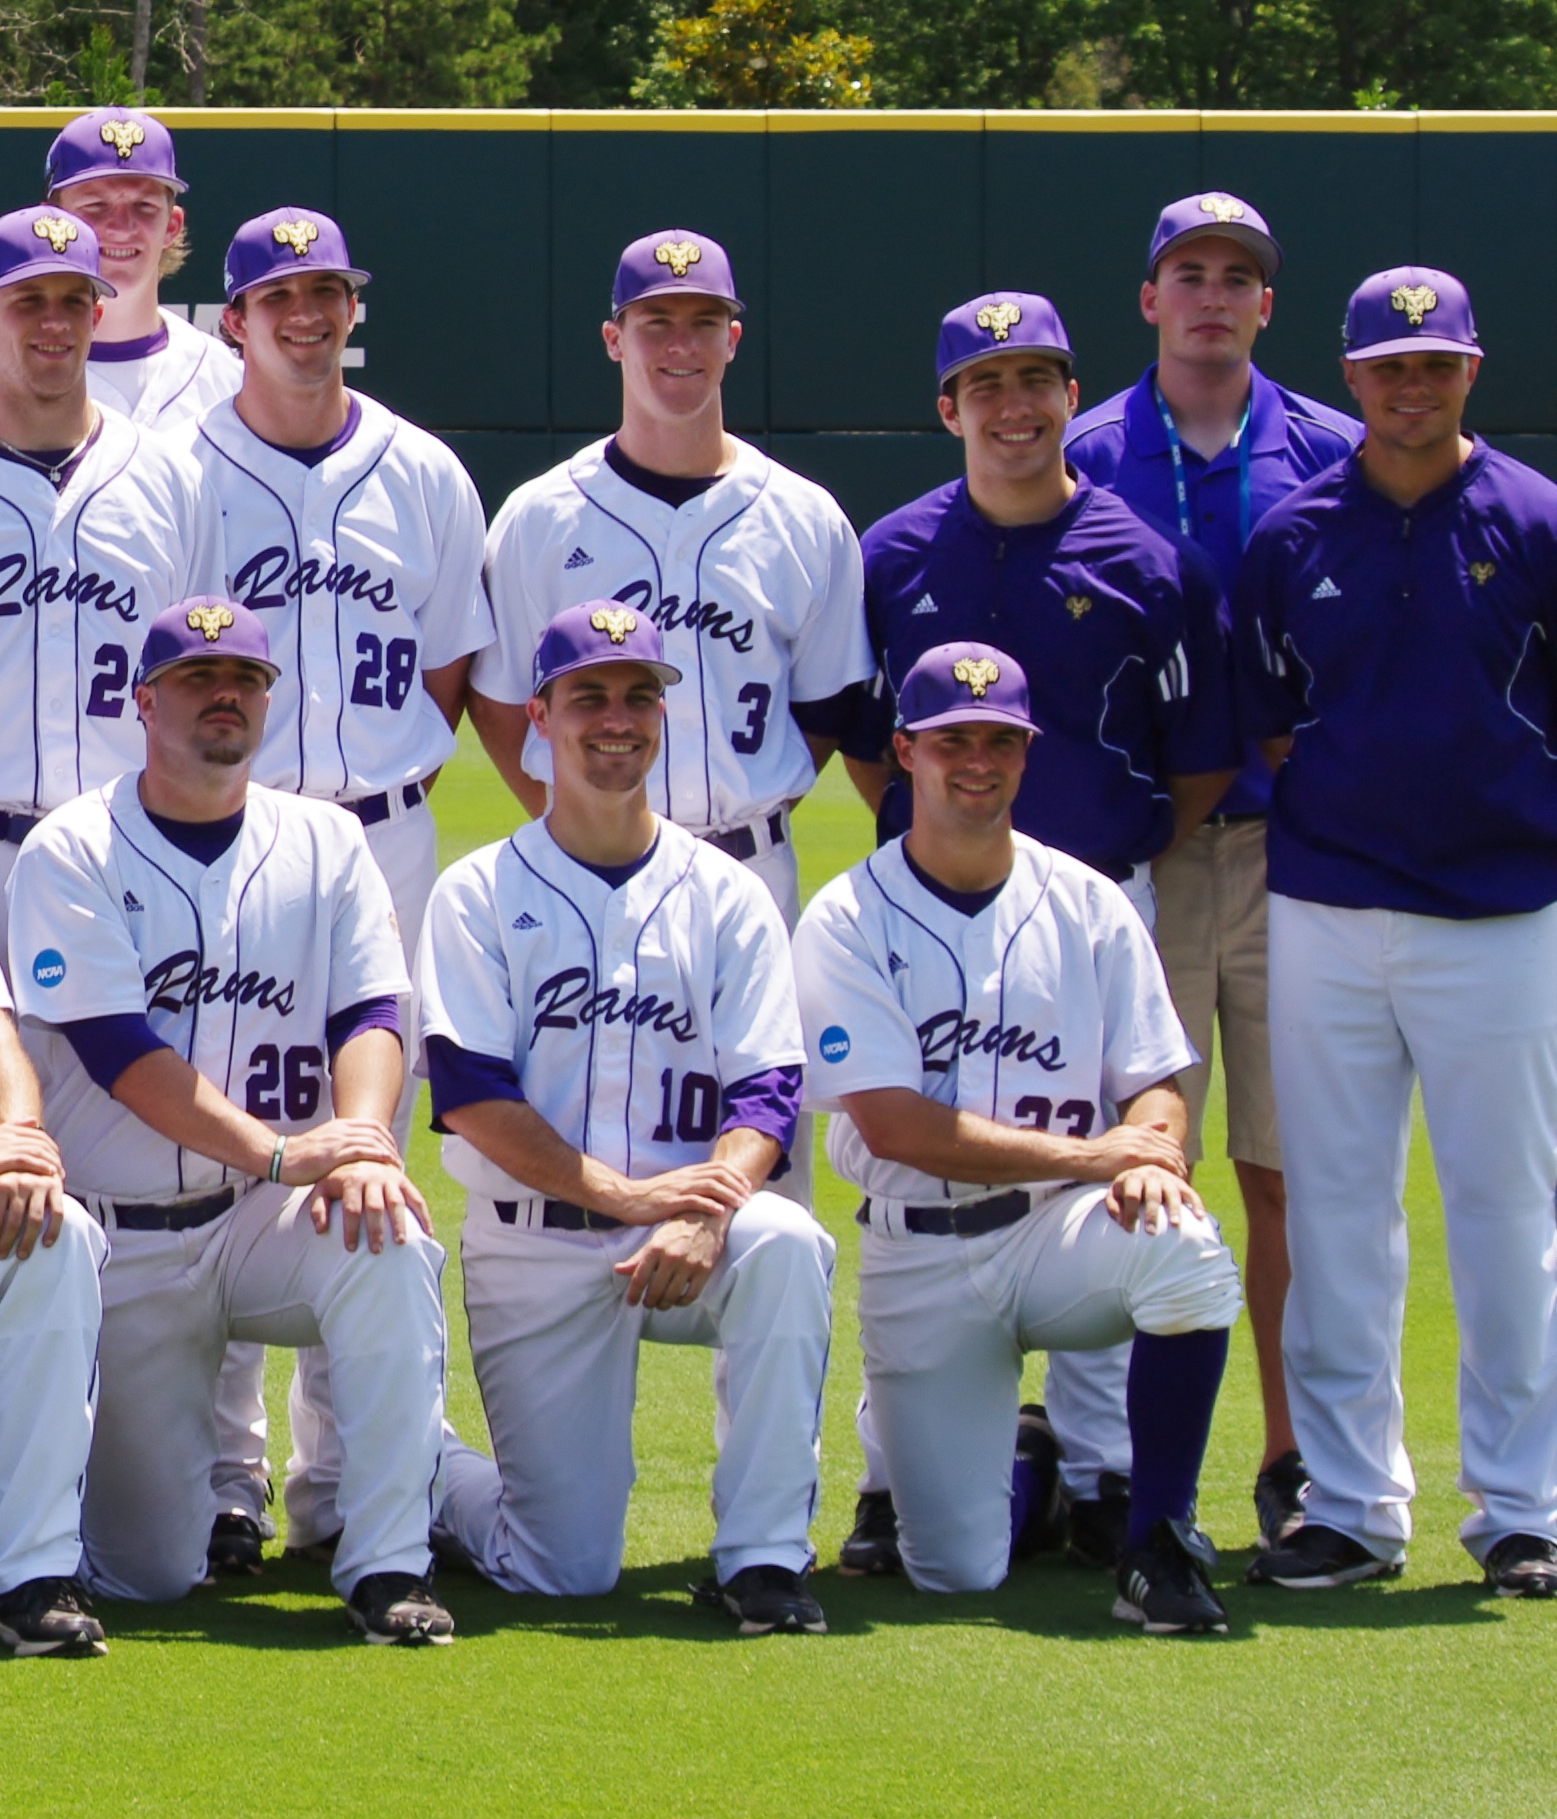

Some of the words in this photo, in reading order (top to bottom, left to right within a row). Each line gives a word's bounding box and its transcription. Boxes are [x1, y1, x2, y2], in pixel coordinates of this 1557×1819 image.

[233, 545, 398, 613] Rams
[565, 557, 594, 570] adidas
[86, 643, 142, 721] 2
[350, 632, 417, 711] 28
[731, 682, 772, 755] 3
[37, 965, 63, 980] NCAA
[147, 950, 296, 1015] Rams
[529, 967, 697, 1050] Rams
[917, 1009, 1067, 1072] Rams
[245, 1044, 327, 1121] 26
[823, 1041, 848, 1056] NCAA
[652, 1067, 719, 1143] 10
